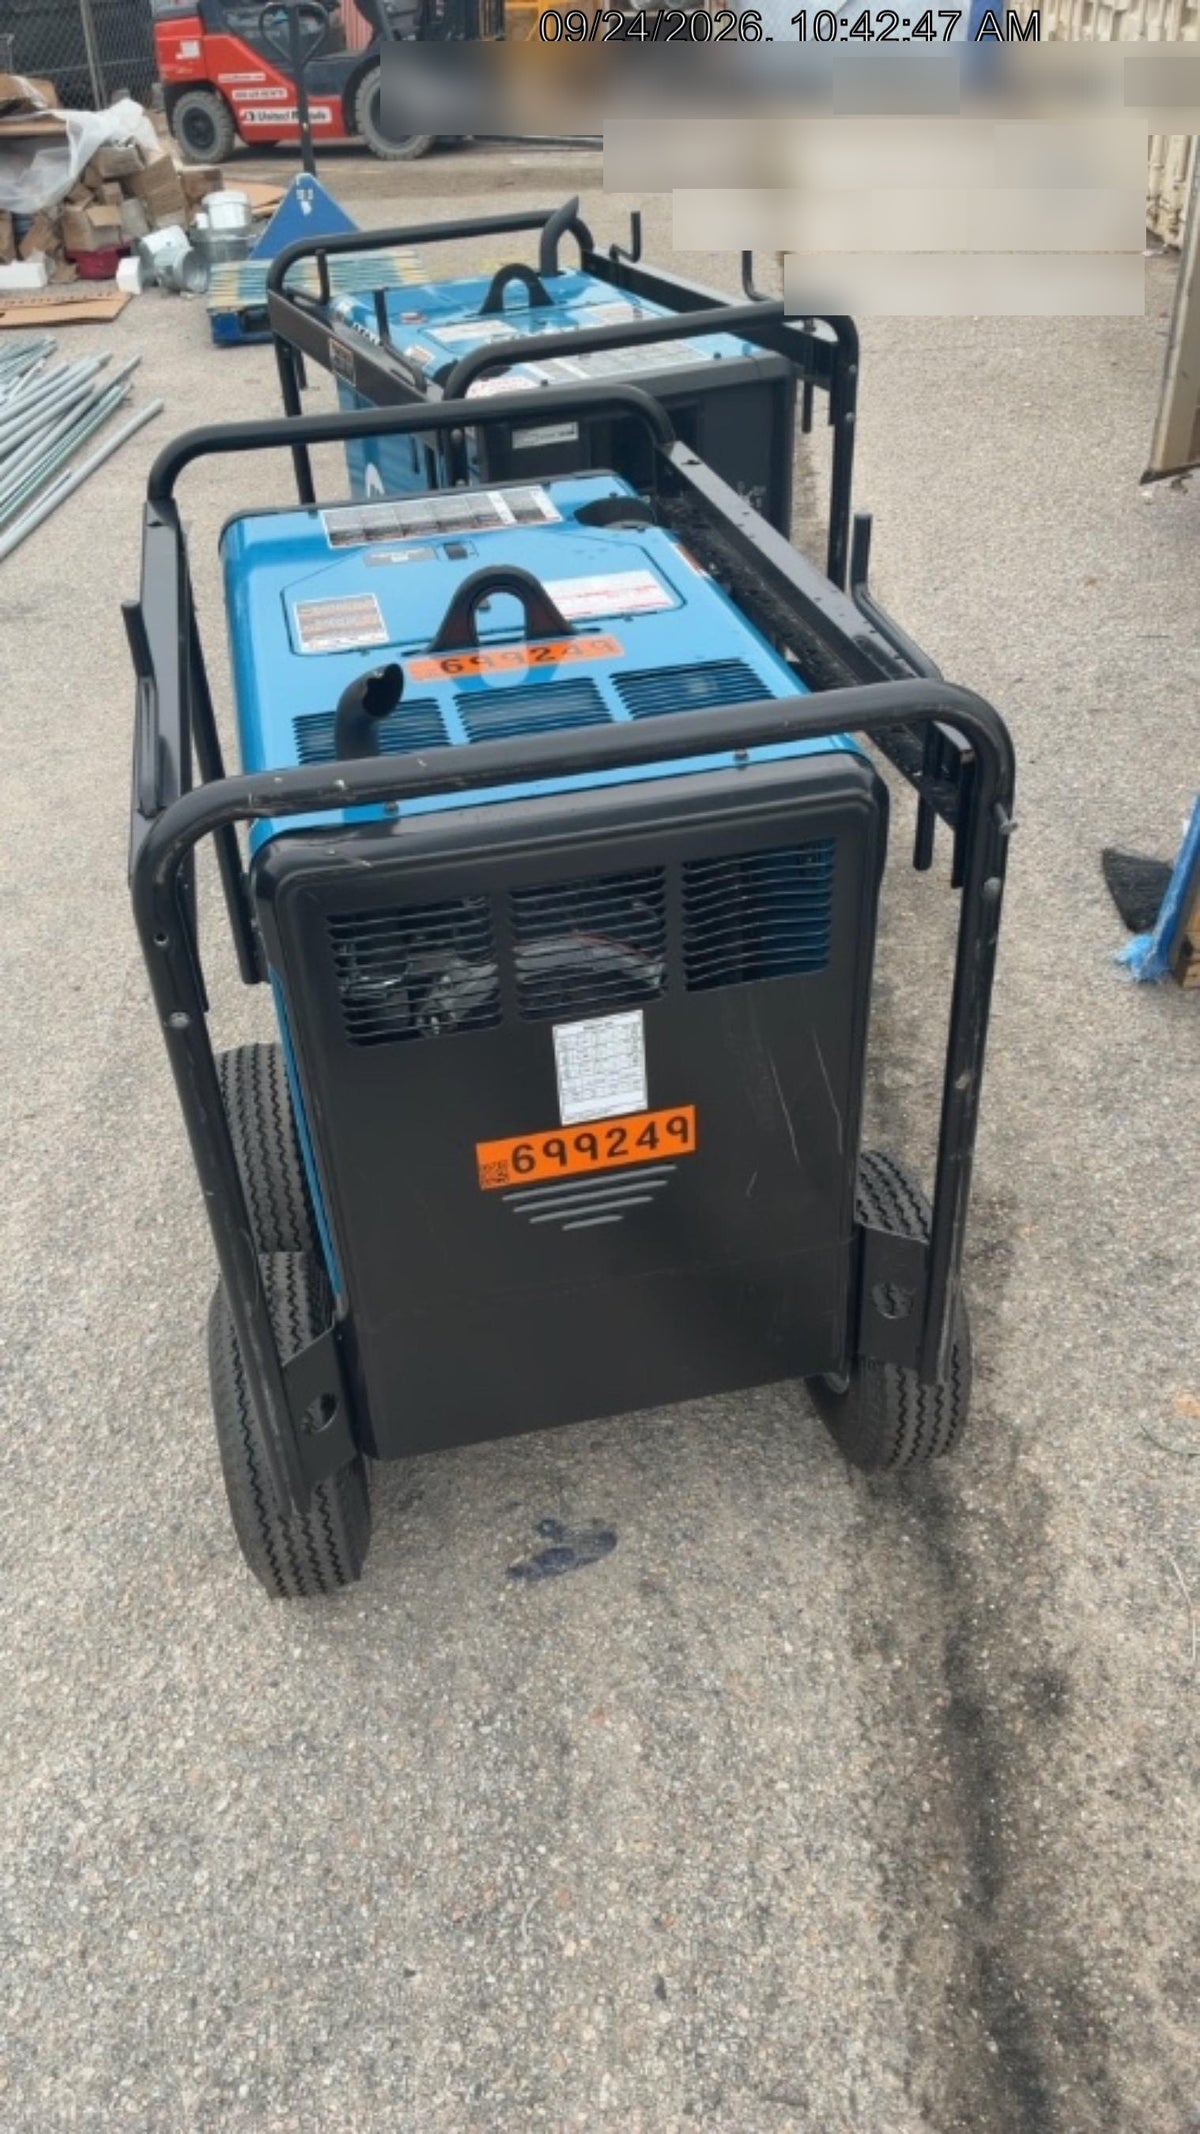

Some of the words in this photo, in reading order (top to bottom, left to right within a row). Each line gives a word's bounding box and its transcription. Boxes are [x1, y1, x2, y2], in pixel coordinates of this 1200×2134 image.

[292, 110, 326, 120] Rtals
[440, 639, 615, 674] 699249
[511, 1115, 689, 1174] 699249
